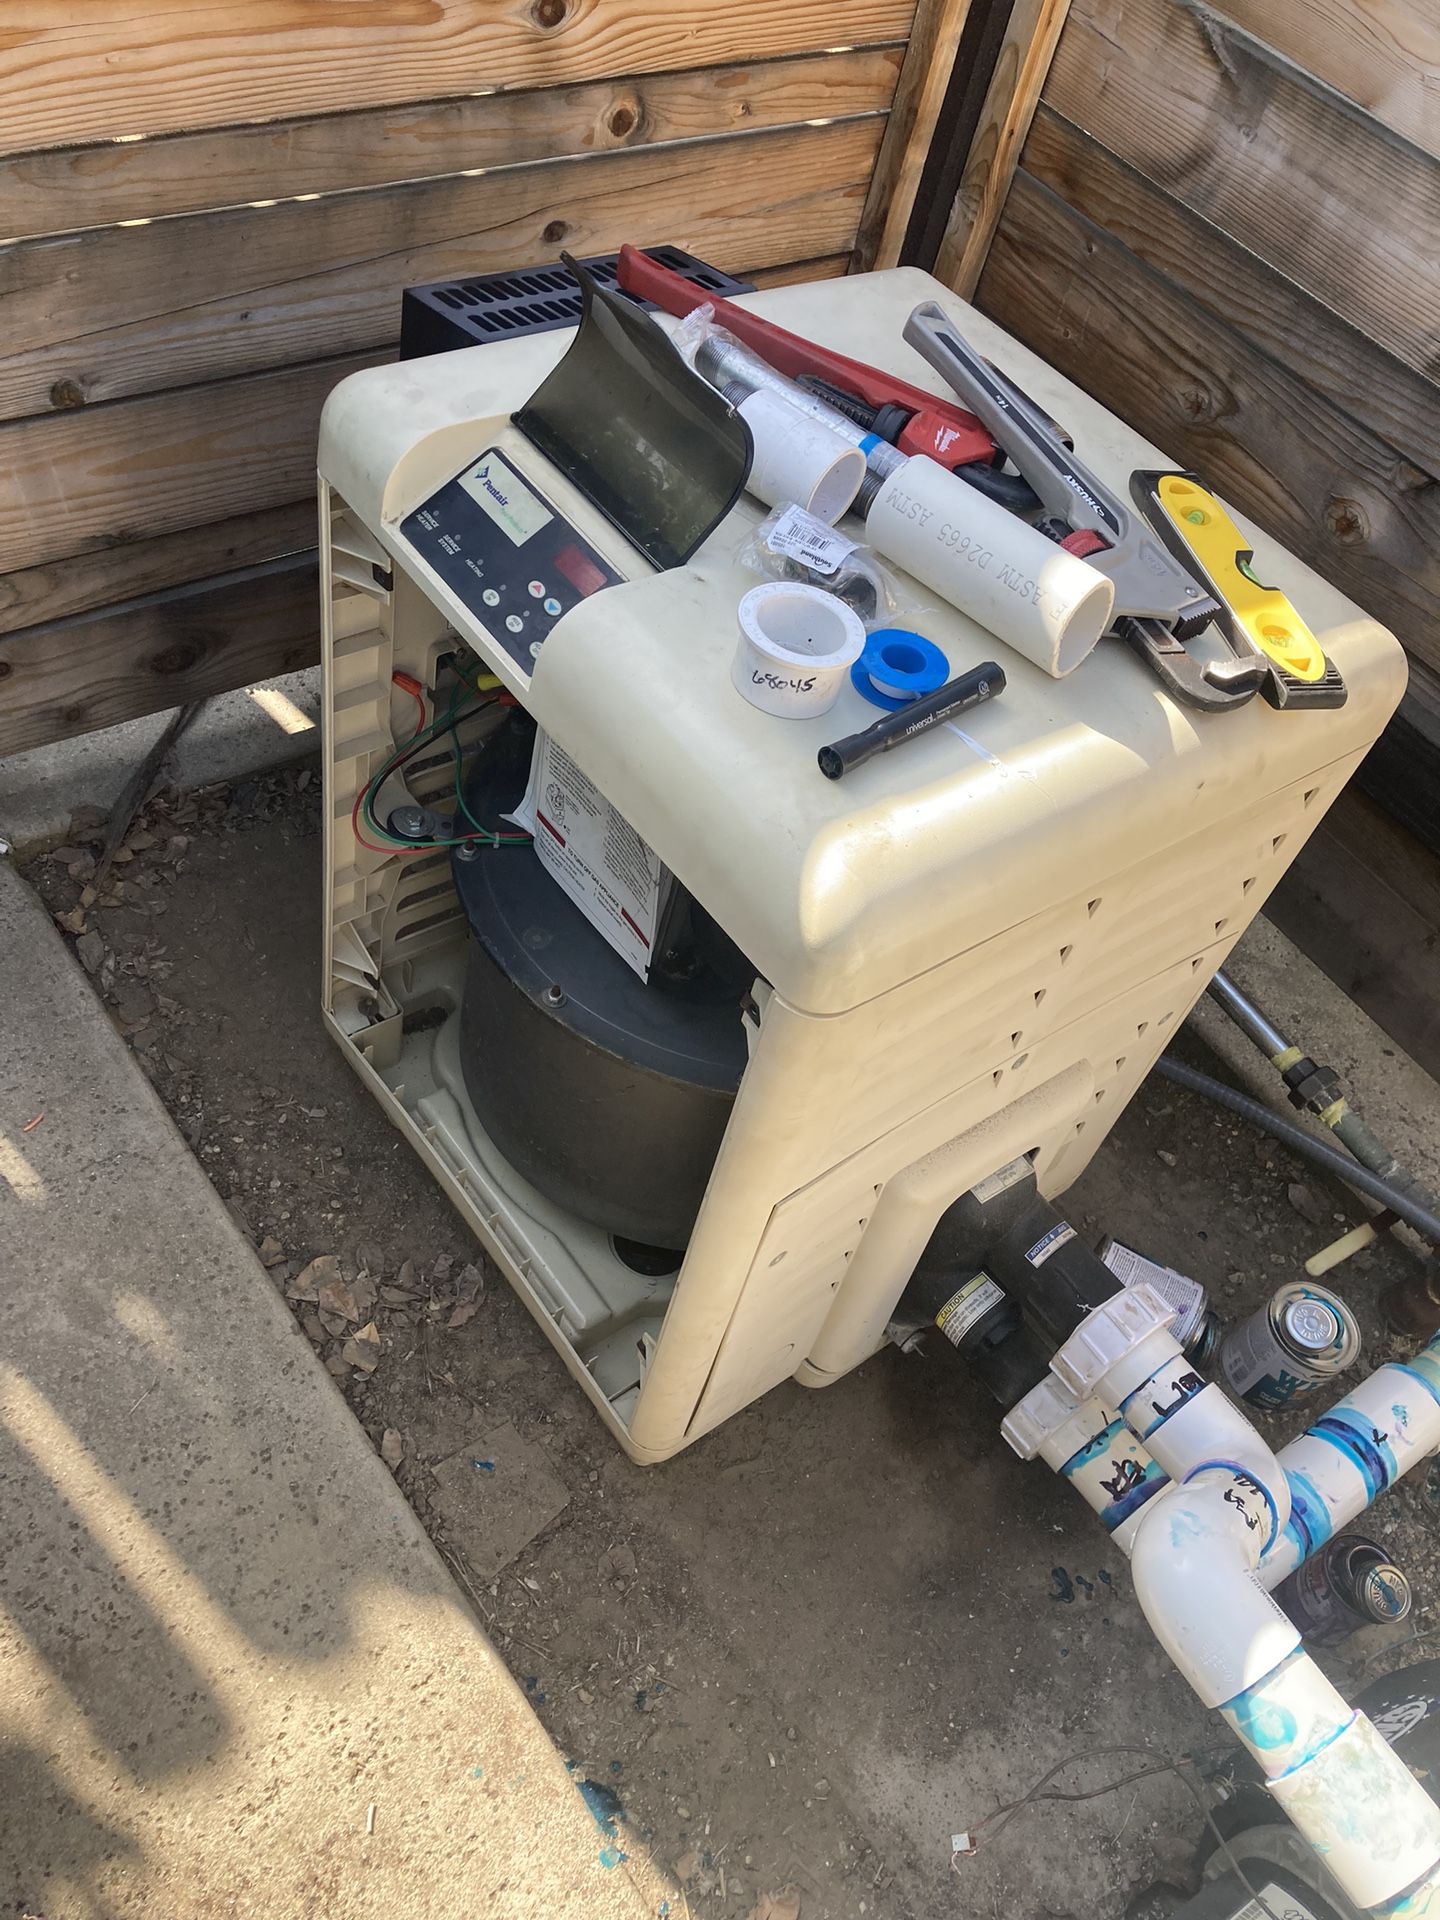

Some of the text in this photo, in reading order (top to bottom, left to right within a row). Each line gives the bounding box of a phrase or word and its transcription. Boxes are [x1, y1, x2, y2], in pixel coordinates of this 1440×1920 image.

[482, 479, 509, 506] Pentair
[1063, 476, 1096, 506] HUSKY
[422, 510, 439, 528] SERVICE
[884, 487, 934, 528] ASTM
[415, 515, 432, 530] HEATER
[438, 539, 454, 555] SYSTEM
[443, 535, 460, 552] SERVICE
[936, 523, 994, 570] D2665
[465, 559, 483, 576] HEATING
[800, 549, 833, 568] Southland
[996, 565, 1047, 606] ASTM
[571, 853, 585, 868] TURN
[582, 866, 592, 876] OFF
[589, 874, 600, 886] GAS
[598, 882, 620, 909] APPLIANCE
[1030, 1237, 1050, 1257] NOTICE
[941, 1293, 964, 1320] CAUTION
